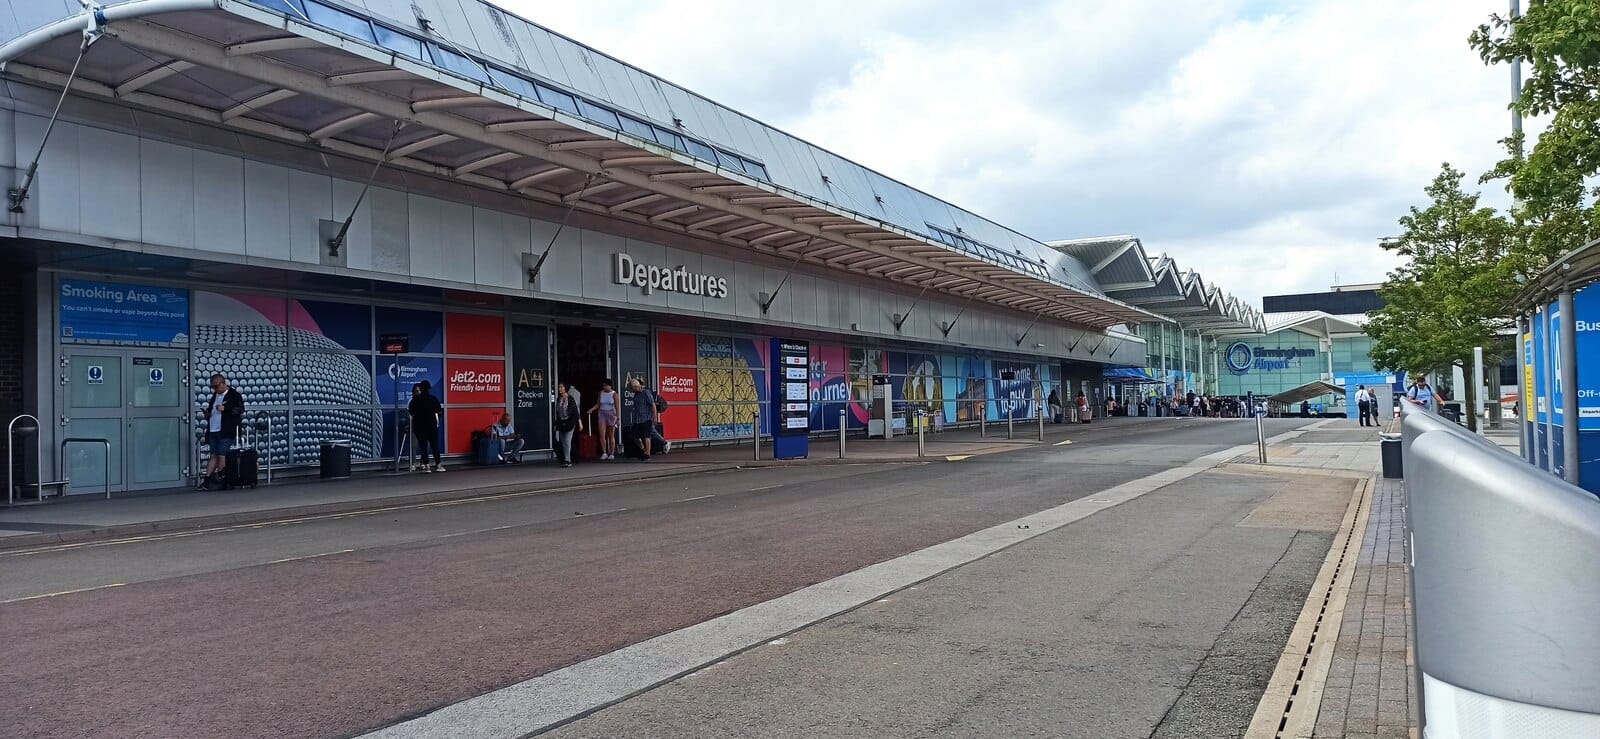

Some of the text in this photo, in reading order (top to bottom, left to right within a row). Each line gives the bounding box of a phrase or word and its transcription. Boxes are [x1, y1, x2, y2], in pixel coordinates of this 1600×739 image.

[612, 252, 727, 298] Departures
[62, 284, 157, 303] Smoking Area
[122, 308, 136, 316] vape
[137, 309, 158, 317] beyond
[1254, 347, 1315, 371] Birmingham Airport
[518, 368, 529, 388] A
[451, 384, 474, 392] Friendly
[486, 384, 500, 392] fares
[518, 390, 543, 398] Check-in
[662, 386, 677, 394] Friendly
